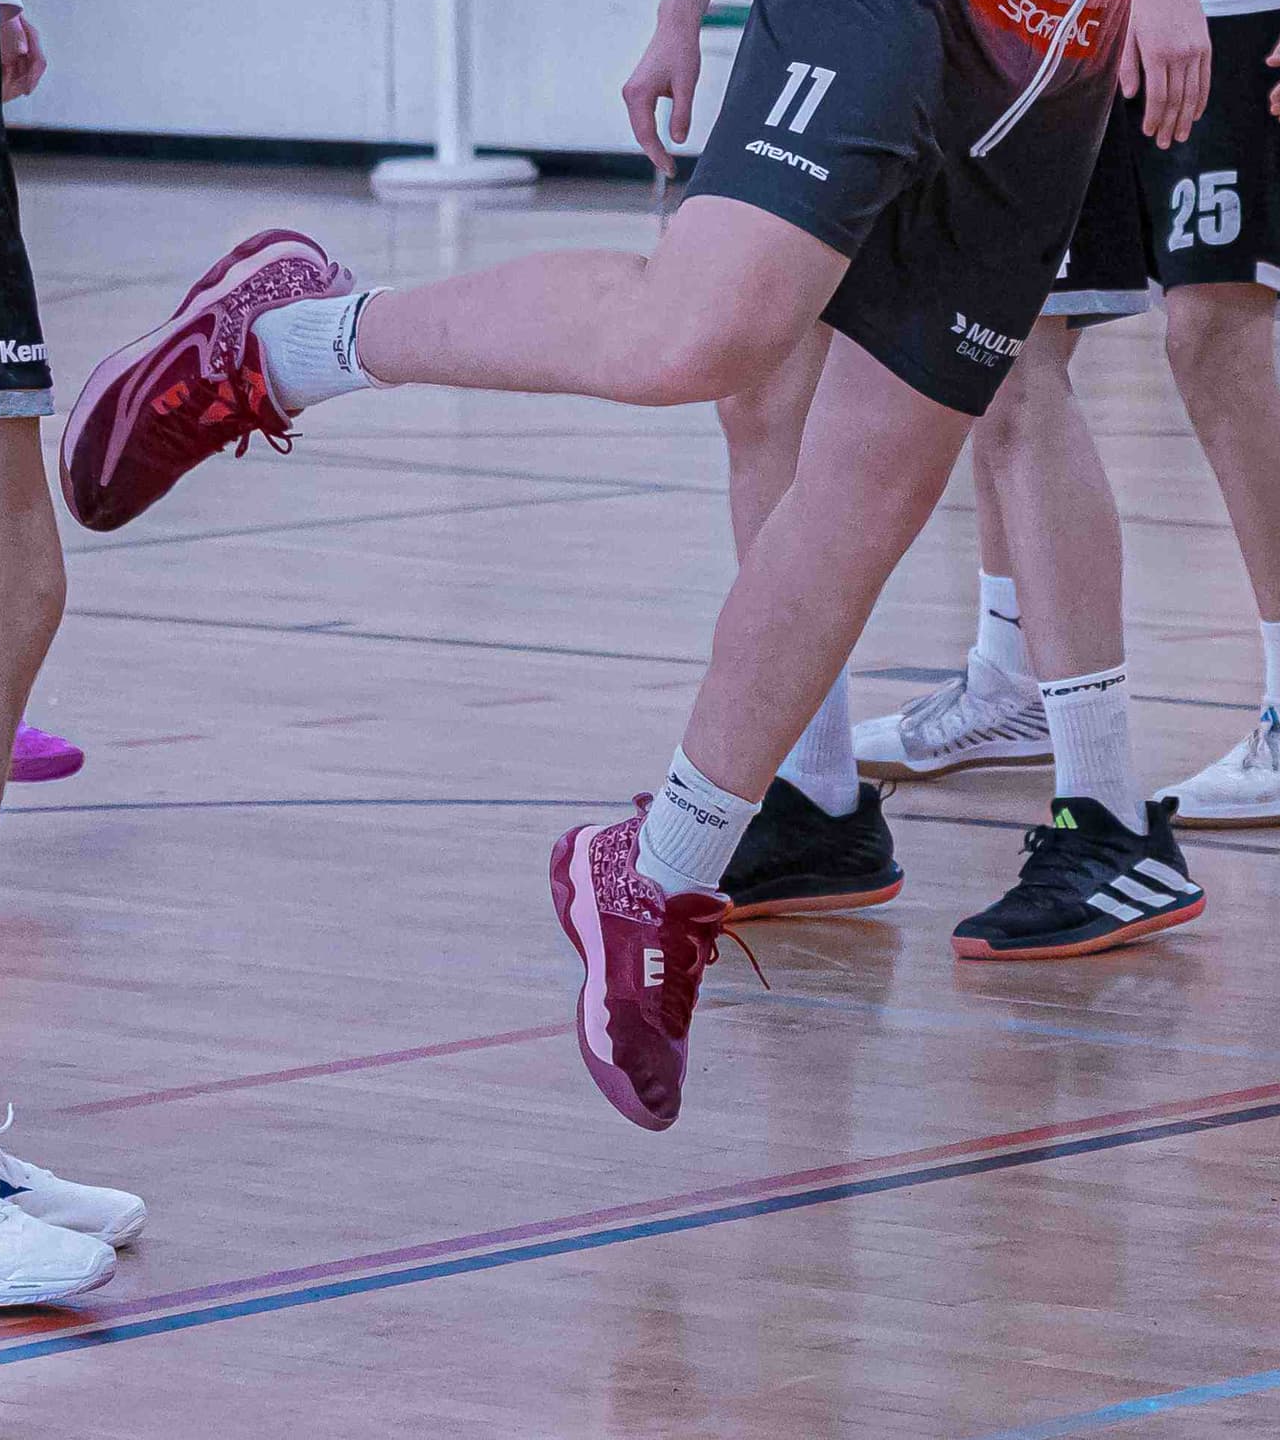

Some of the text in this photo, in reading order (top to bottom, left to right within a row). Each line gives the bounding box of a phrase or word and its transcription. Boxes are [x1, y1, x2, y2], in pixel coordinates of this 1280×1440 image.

[764, 61, 837, 134] 11
[1168, 170, 1242, 252] 25
[956, 340, 1000, 368] BALTIC
[1041, 673, 1126, 698] Kempa
